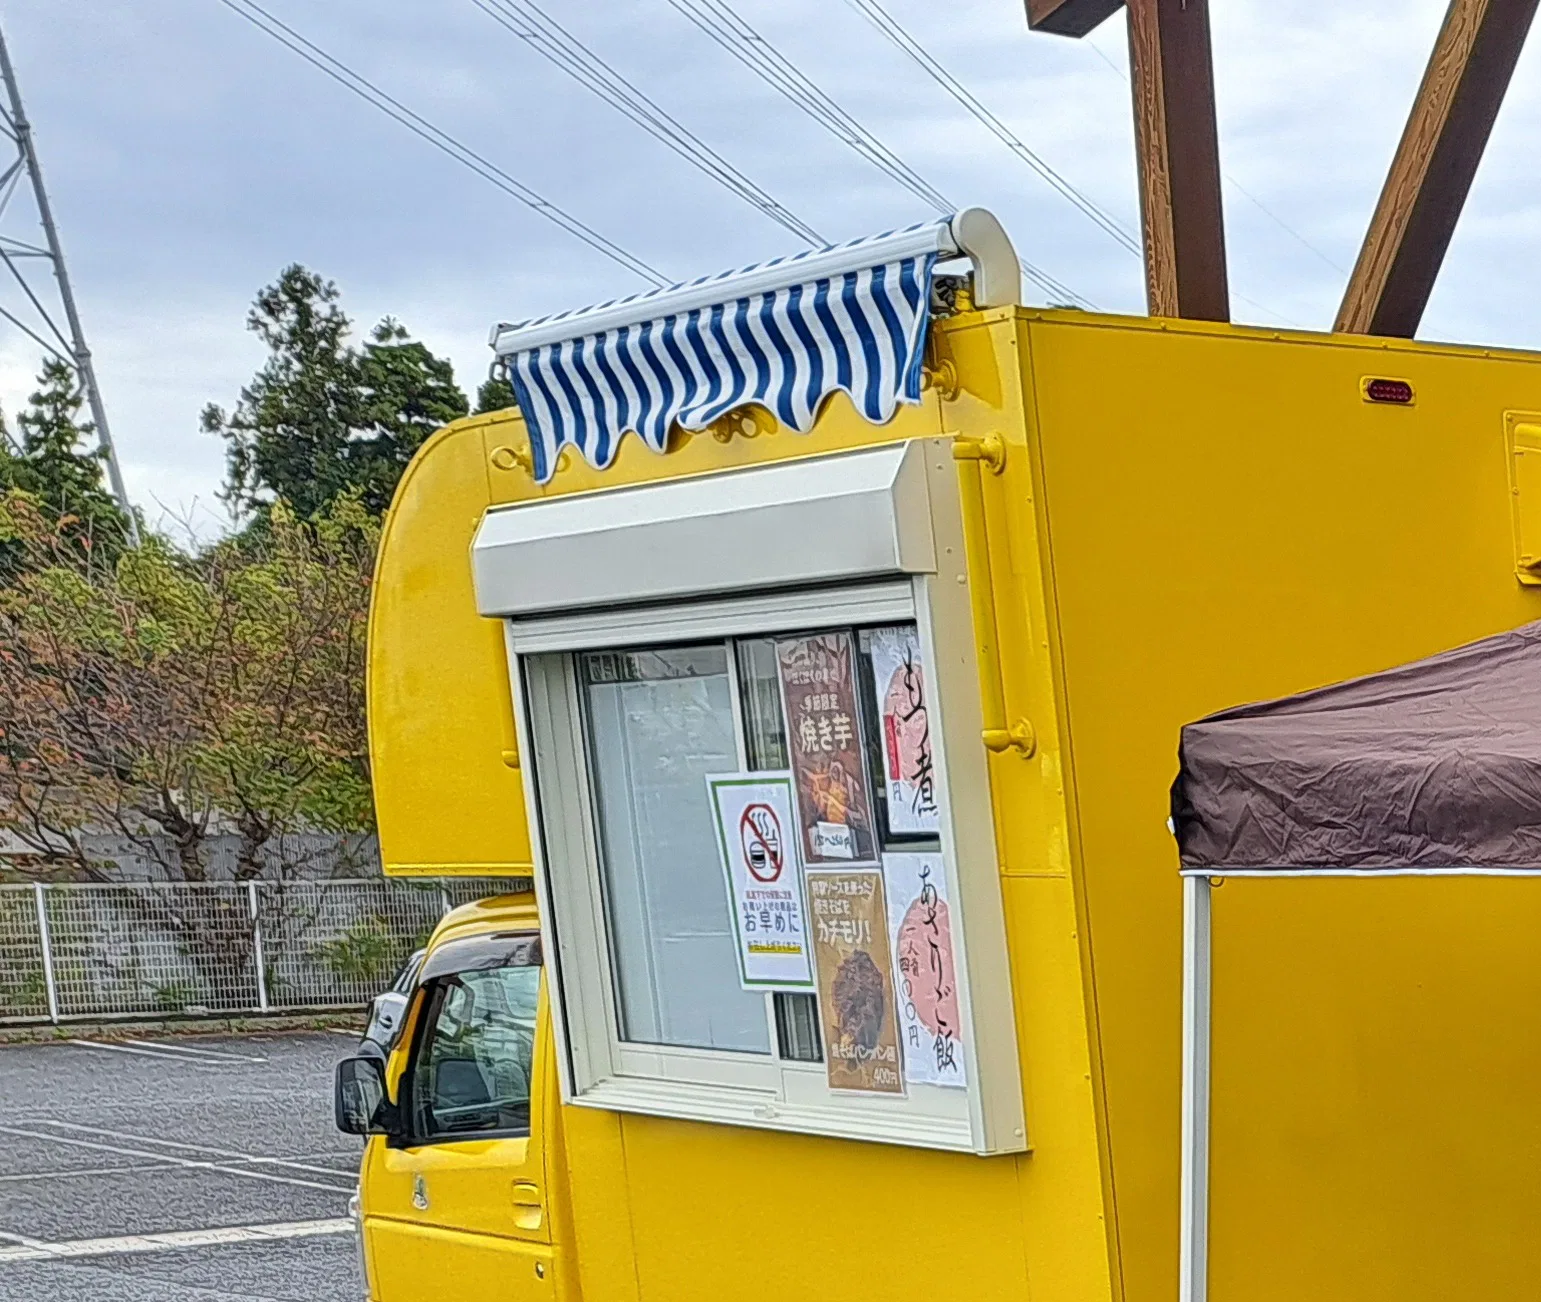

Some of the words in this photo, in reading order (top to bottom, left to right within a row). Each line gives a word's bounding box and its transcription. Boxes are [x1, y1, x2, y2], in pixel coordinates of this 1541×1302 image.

[801, 713, 852, 752] 焼き芋
[744, 911, 800, 933] お早めに
[918, 864, 957, 1072] あさりご飯
